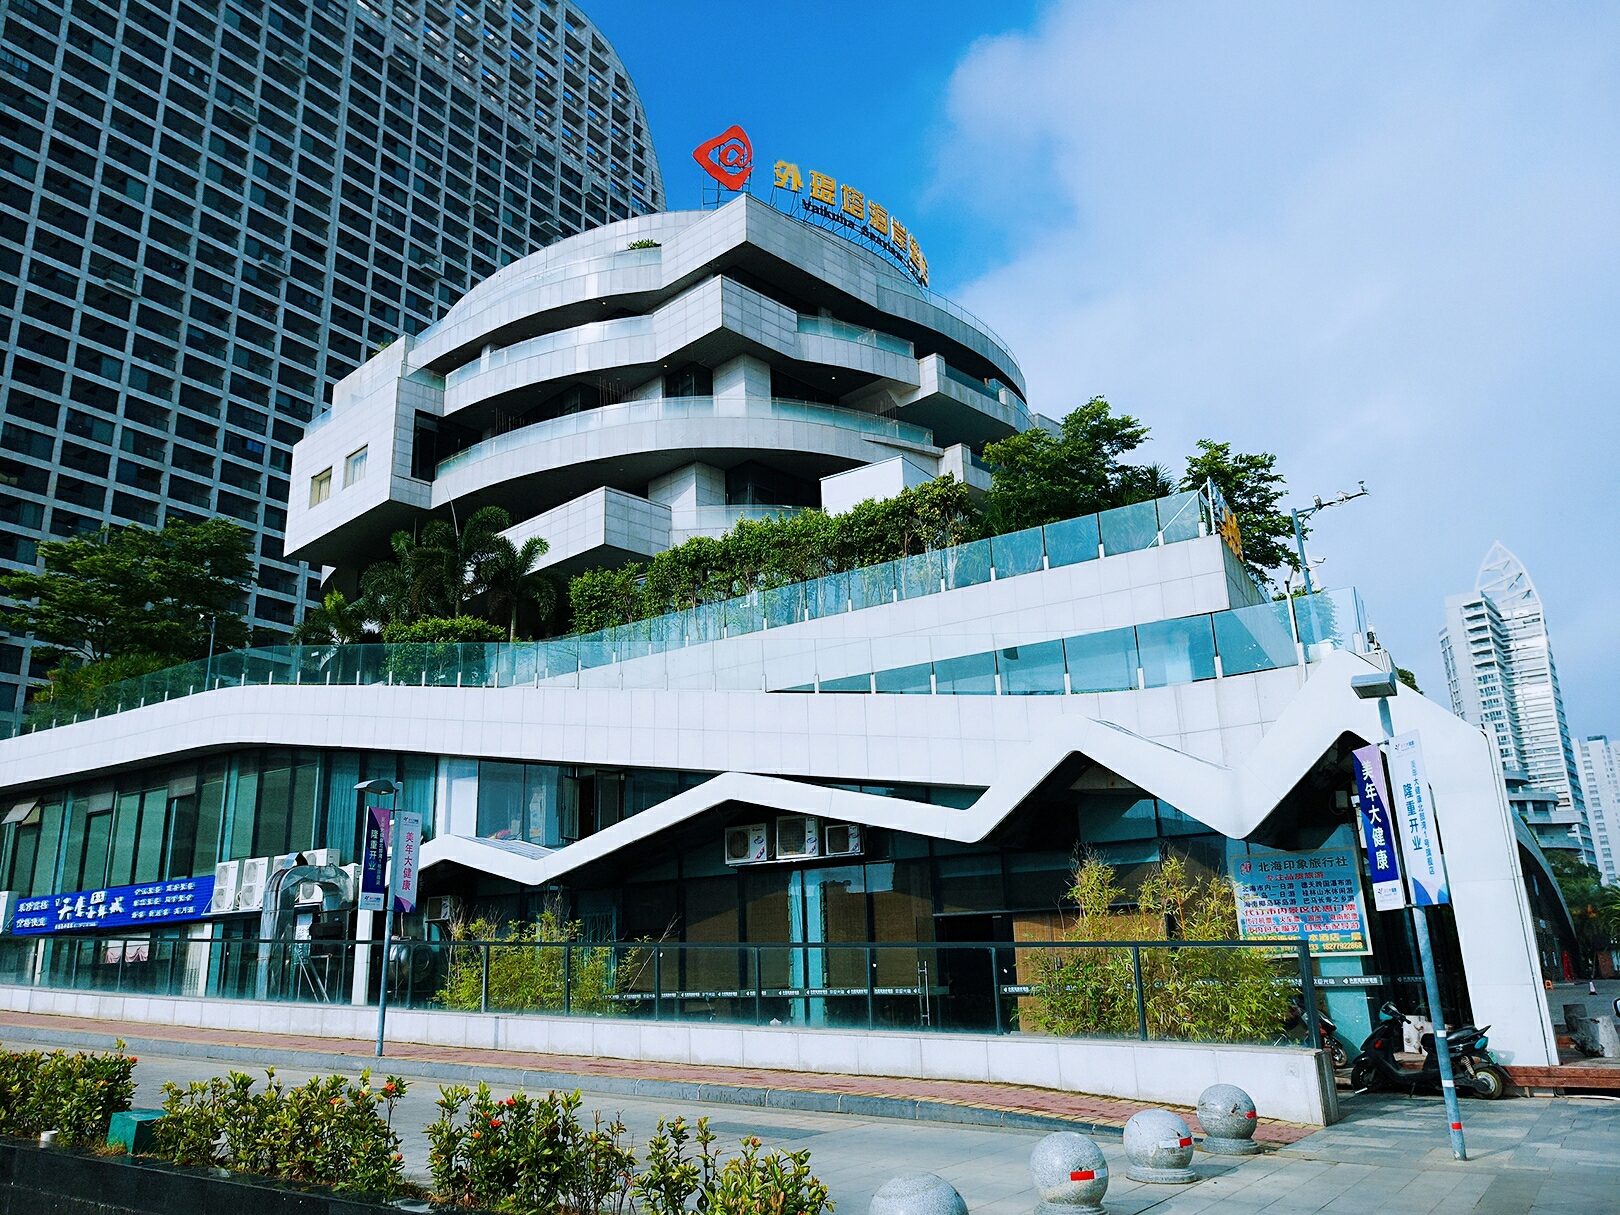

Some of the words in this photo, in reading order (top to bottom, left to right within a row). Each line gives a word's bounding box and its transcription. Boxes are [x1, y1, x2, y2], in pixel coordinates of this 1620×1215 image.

[1362, 760, 1389, 870] 美年大健康
[1403, 783, 1422, 851] 隆重开业
[368, 829, 379, 871] 隆重开业
[402, 832, 414, 891] 美年大健康
[1258, 856, 1348, 872] 北海印象旅行社
[1243, 891, 1296, 899] 岛一日游
[1302, 887, 1353, 896] 桂林山水休闲游
[1303, 895, 1355, 904] 巴马长寿之乡游
